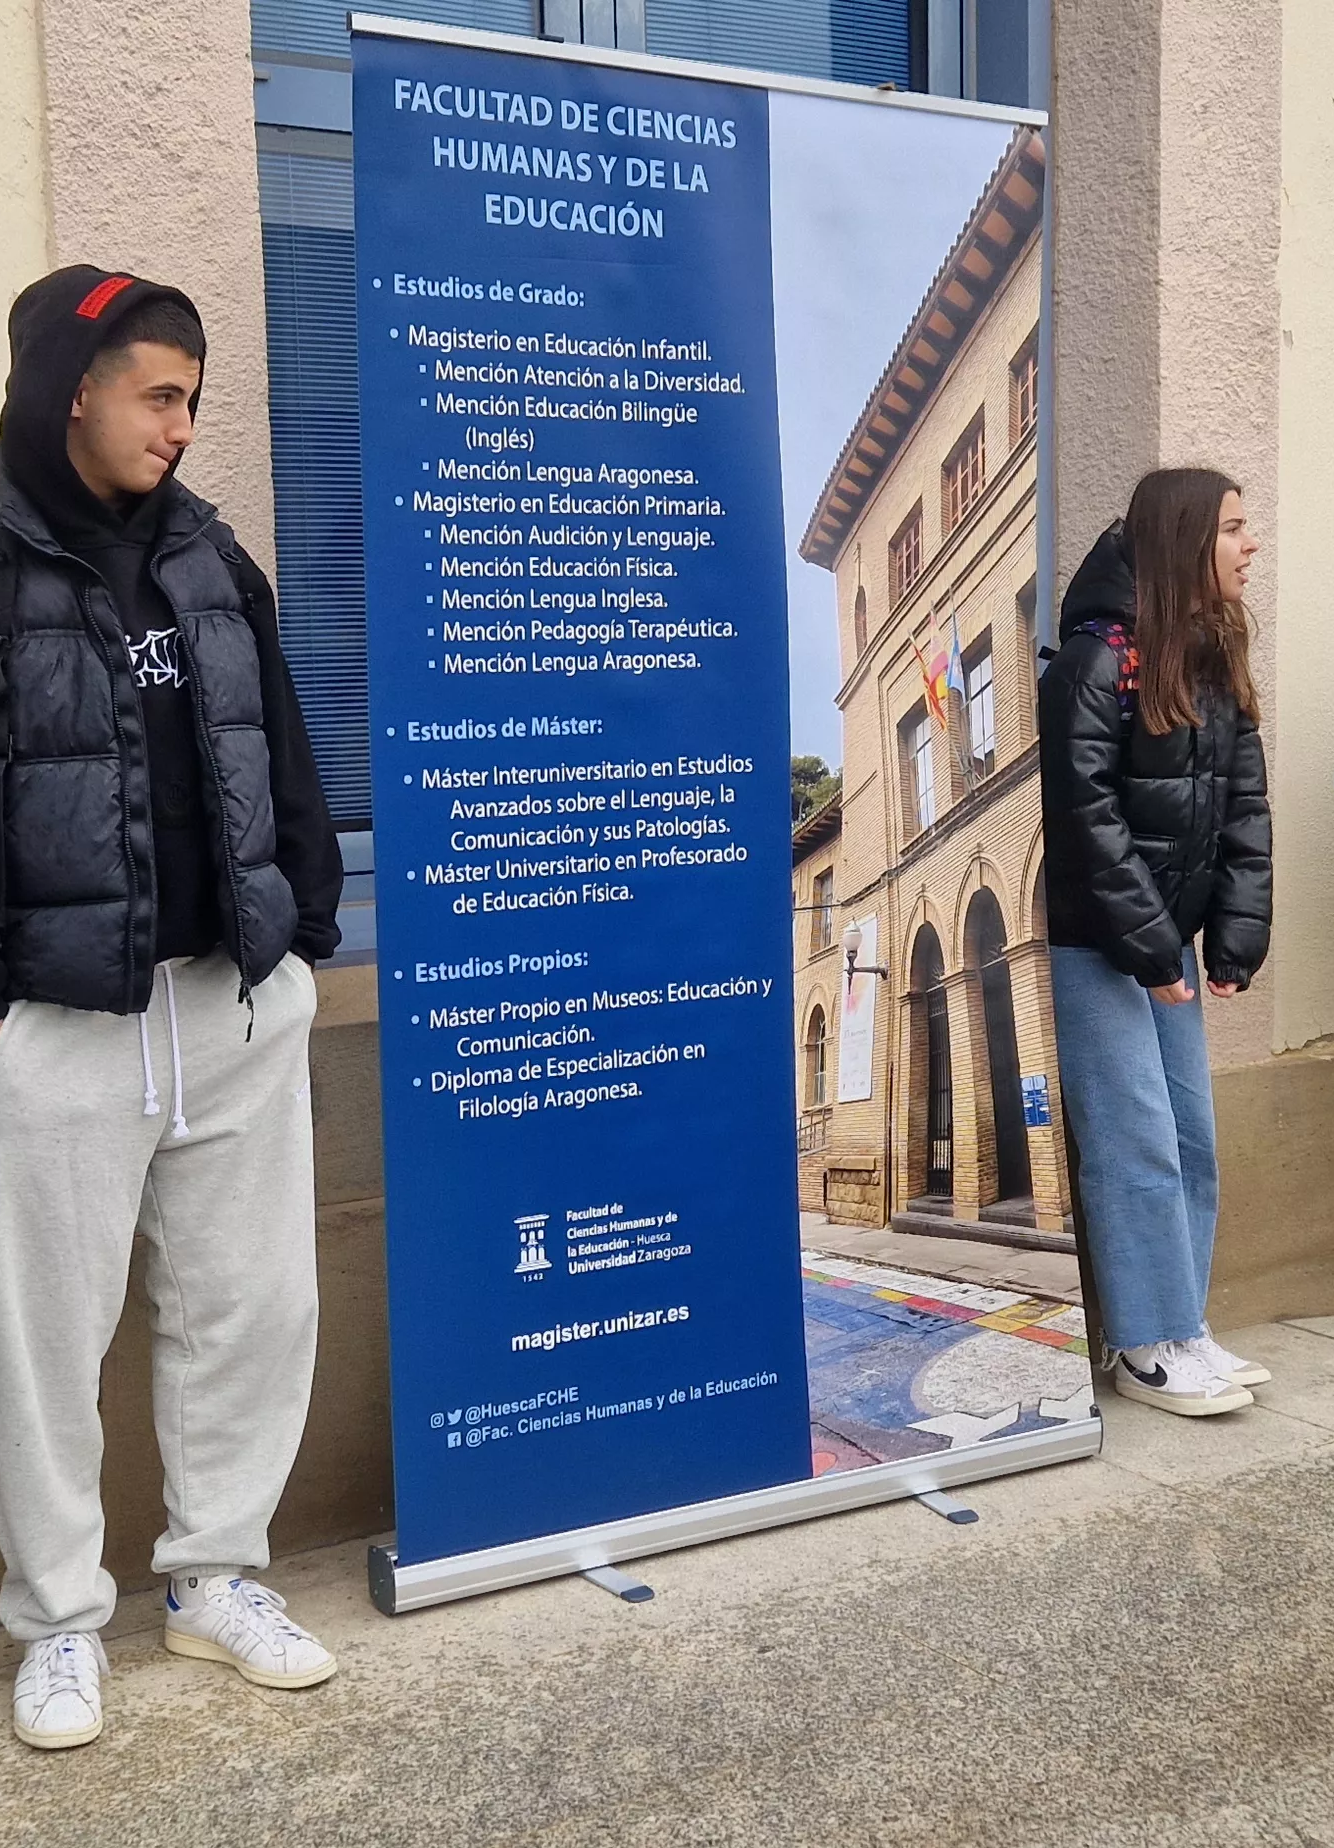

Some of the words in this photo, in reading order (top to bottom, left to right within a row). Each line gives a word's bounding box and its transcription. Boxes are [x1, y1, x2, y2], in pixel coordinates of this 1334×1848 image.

[395, 78, 553, 126] FACULTAD
[561, 100, 599, 133] DE
[607, 106, 736, 149] CIENCIAS
[433, 136, 592, 182] HUMANAS
[597, 155, 617, 185] Y
[626, 158, 665, 189] DE
[674, 162, 709, 193] LA
[485, 194, 663, 238] EDUCACIÓN
[394, 273, 484, 300] Estudios
[489, 280, 514, 302] de
[519, 283, 584, 307] Grado:
[409, 325, 511, 353] Magisterio
[516, 336, 539, 352] en
[545, 333, 636, 358] Educación
[642, 338, 711, 361] Infantil.
[435, 359, 518, 384] Mención
[524, 364, 604, 388] Atención
[609, 374, 619, 389] a
[624, 369, 639, 390] la
[644, 371, 745, 394] Diversidad.
[436, 392, 519, 416] Mención
[525, 396, 616, 420] Educación
[622, 401, 698, 427] Bilingüe
[466, 426, 534, 453] (Inglés)
[438, 459, 521, 480] Mención
[527, 461, 593, 487] Lengua
[598, 463, 699, 489] Aragonesa.
[414, 491, 516, 518] Magisterio
[520, 498, 543, 513] en
[549, 493, 639, 515] Educación
[645, 496, 726, 516] Primaria.
[440, 524, 522, 545] Mención
[528, 525, 607, 546] Audición
[612, 531, 622, 551] y
[627, 526, 715, 551] Lenguaje.
[441, 556, 523, 577] Mención
[529, 556, 620, 577] Educación
[626, 557, 678, 576] Física.
[442, 588, 524, 609] Mención
[530, 588, 596, 613] Lengua
[602, 587, 668, 613] Inglesa.
[443, 620, 525, 642] Mención
[531, 619, 624, 645] Pedagogía
[628, 618, 738, 643] Terapéutica.
[444, 652, 526, 674] Mención
[532, 652, 598, 676] Lengua
[603, 651, 701, 674] Aragonesa.
[408, 719, 497, 741] Estudios
[501, 717, 526, 737] de
[532, 716, 602, 736] Máster:
[423, 768, 489, 789] Máster
[494, 759, 647, 785] Interuniversitario
[651, 762, 672, 776] en
[678, 753, 753, 775] Estudios
[450, 794, 552, 819] Avanzados
[557, 792, 606, 813] sobre
[610, 789, 625, 809] el
[631, 786, 715, 811] Lenguaje,
[720, 784, 735, 803] la
[451, 824, 584, 851] Comunicación
[589, 827, 599, 847] y
[604, 825, 631, 841] sus
[636, 815, 730, 839] Patologías.
[425, 863, 491, 885] Máster
[496, 853, 610, 879] Universitario
[615, 855, 636, 870] en
[642, 842, 747, 868] Profesorado
[453, 893, 477, 914] de
[483, 886, 577, 912] Educación
[582, 883, 634, 903] Física.
[416, 957, 503, 982] Estudios
[509, 949, 588, 975] Propios:
[430, 1006, 495, 1029] Máster
[500, 997, 560, 1022] Propio
[565, 998, 587, 1013] en
[593, 990, 663, 1010] Museos:
[668, 976, 757, 1002] Educación
[762, 979, 772, 997] y
[457, 1024, 595, 1057] Comunicación.
[432, 1067, 513, 1094] Diploma
[518, 1060, 542, 1080] de
[547, 1044, 678, 1079] Especialización
[683, 1044, 705, 1059] en
[460, 1091, 538, 1119] Filología
[544, 1082, 642, 1109] Aragonesa.
[566, 1204, 609, 1222] Facultad
[610, 1203, 623, 1215] de
[567, 1224, 608, 1239] Ciencias
[609, 1217, 656, 1232] Humanas
[657, 1215, 663, 1227] y
[665, 1211, 678, 1223] de
[567, 1246, 577, 1258] la
[578, 1238, 629, 1256] Educación
[637, 1233, 671, 1246] Huesca
[569, 1252, 636, 1274] Universidad
[637, 1245, 691, 1263] Zaragoza
[512, 1306, 689, 1351] magister.unizar.es
[465, 1387, 579, 1425] @HuescaFCHE
[466, 1426, 513, 1447] @Fac.
[518, 1411, 581, 1433] Ciencias
[586, 1398, 653, 1420] Humanas
[656, 1395, 665, 1410] y
[669, 1389, 686, 1404] de
[690, 1386, 701, 1400] la
[706, 1371, 777, 1396] Educación
